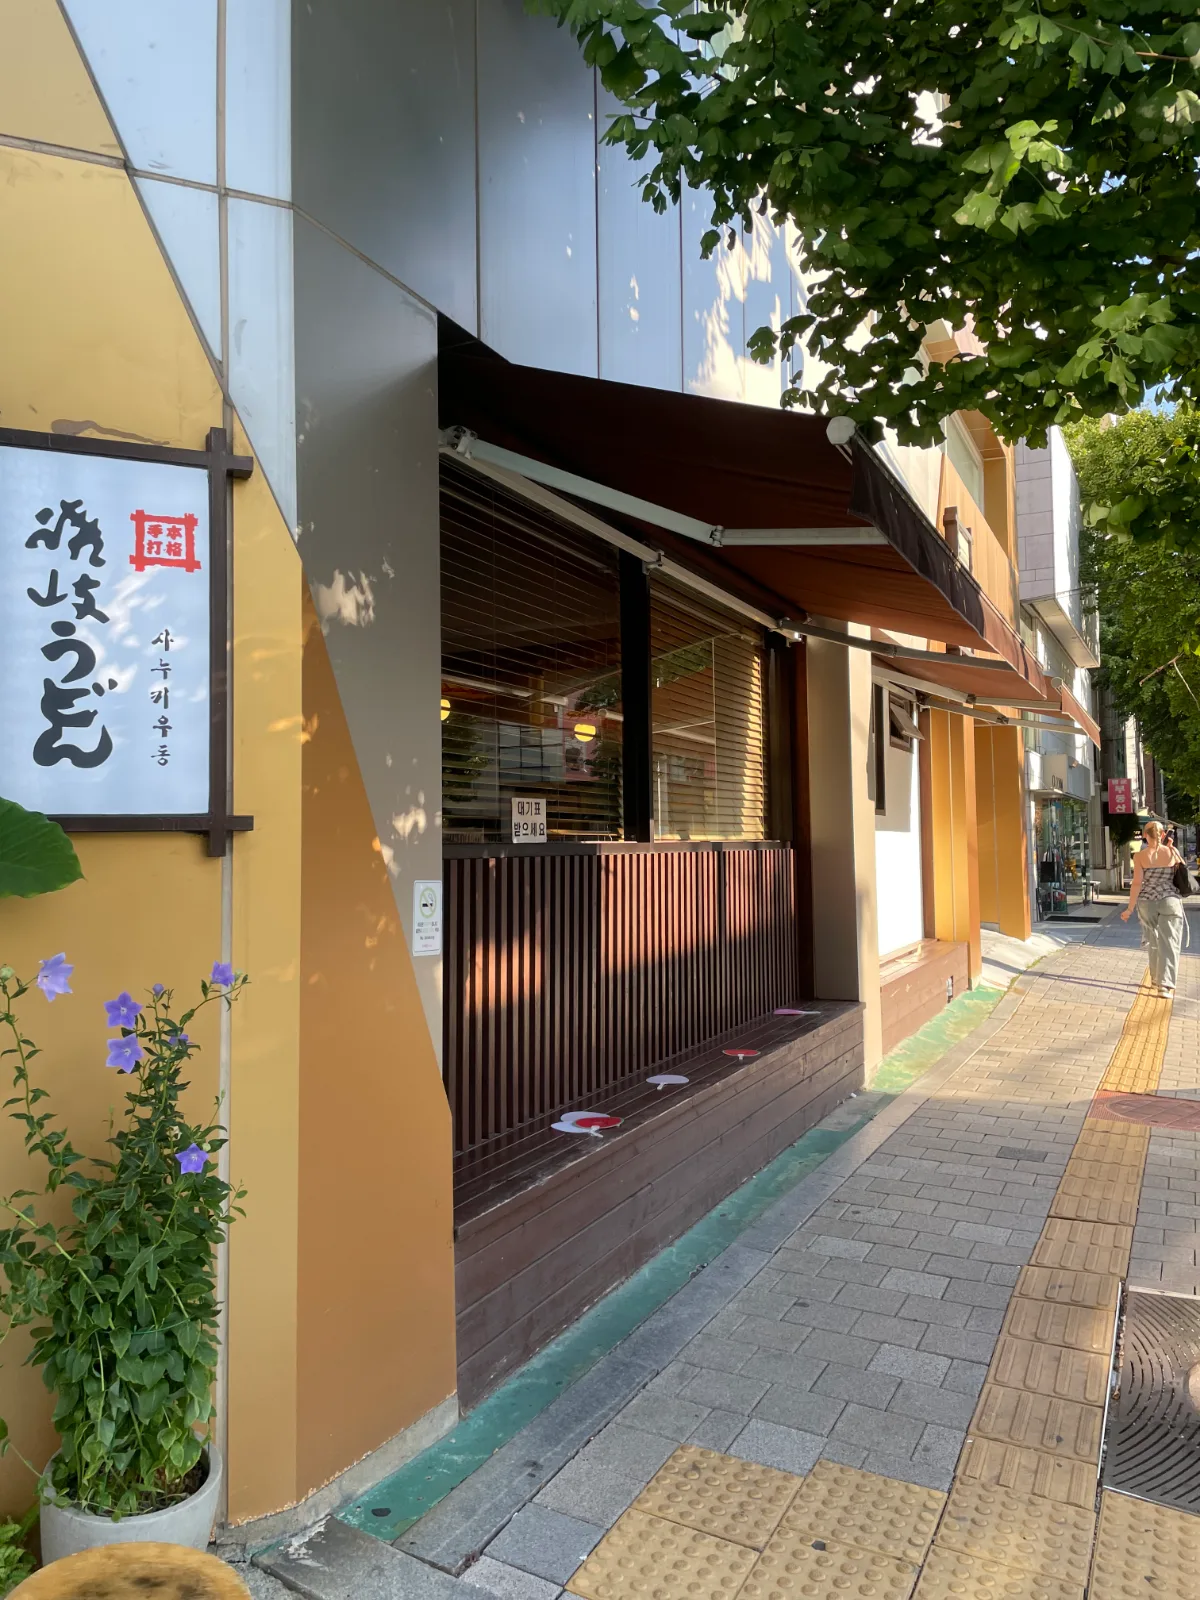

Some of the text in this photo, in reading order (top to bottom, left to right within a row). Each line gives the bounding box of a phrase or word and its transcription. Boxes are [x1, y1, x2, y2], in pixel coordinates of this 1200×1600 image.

[150, 628, 174, 766] 사누키우동
[517, 801, 541, 816] 대기표
[514, 822, 545, 837] 받으세요
